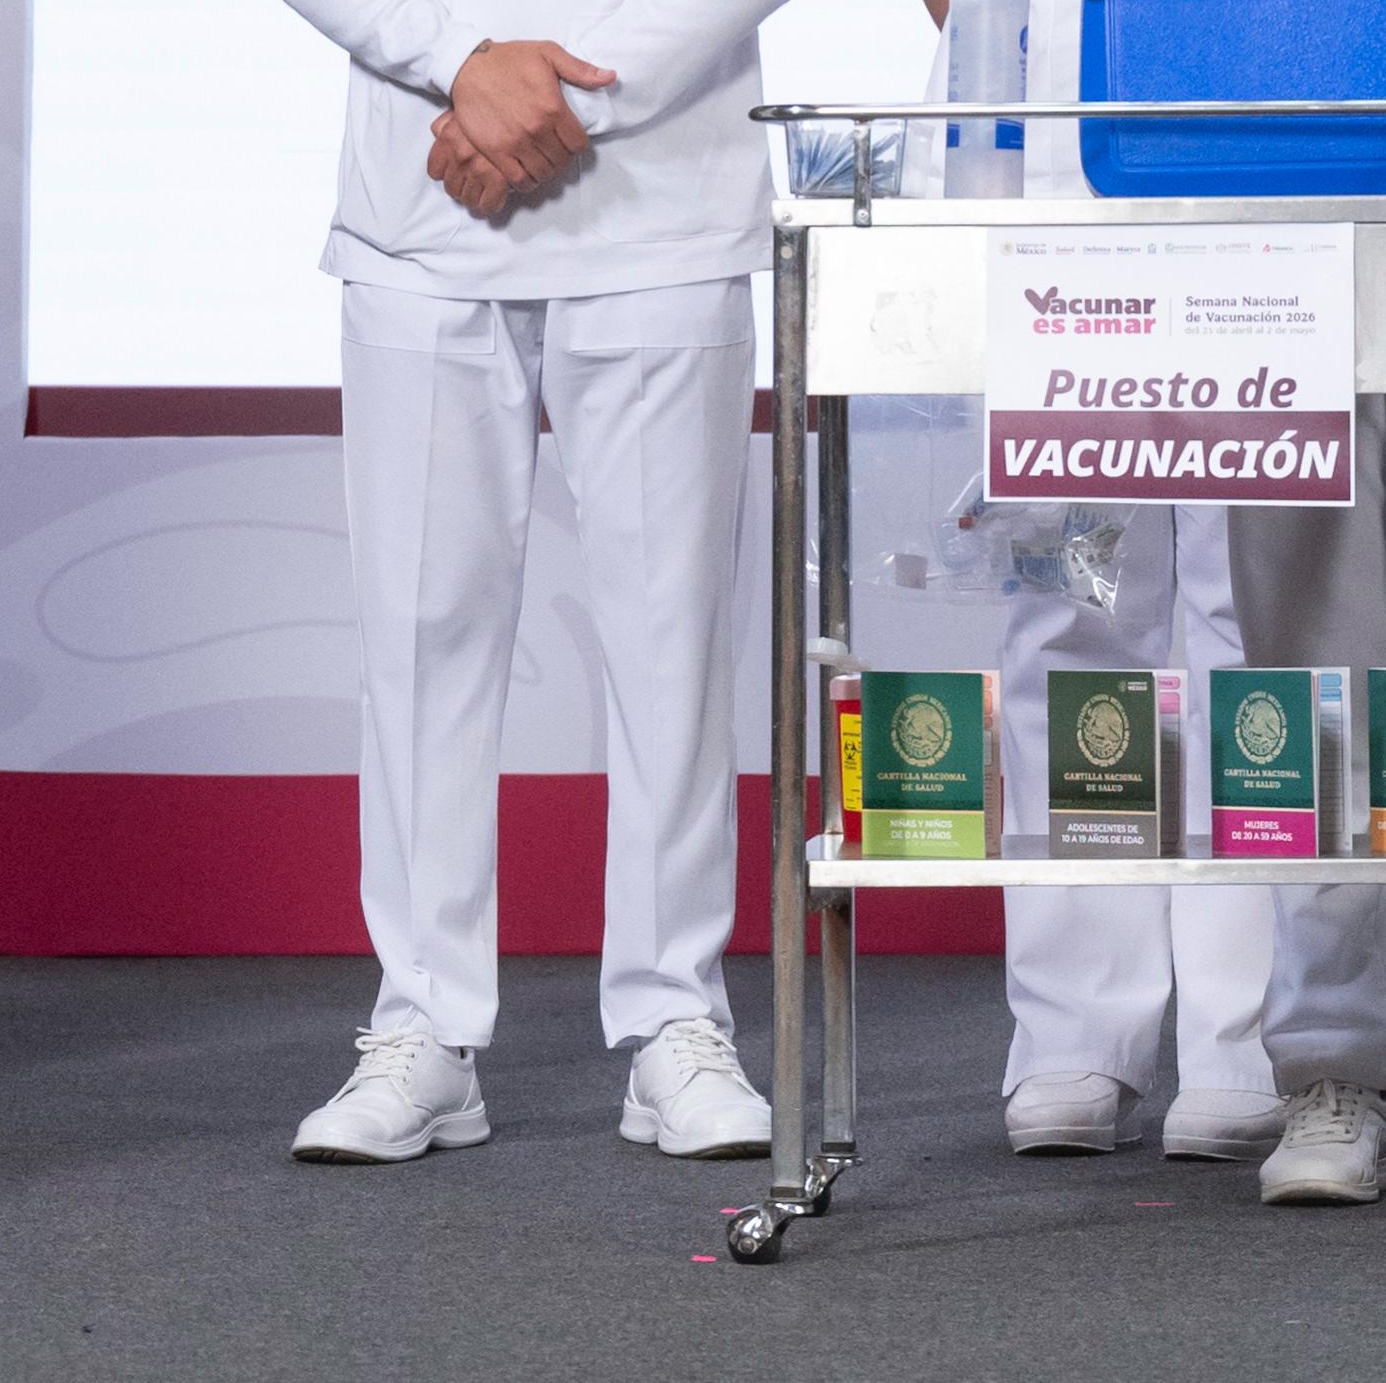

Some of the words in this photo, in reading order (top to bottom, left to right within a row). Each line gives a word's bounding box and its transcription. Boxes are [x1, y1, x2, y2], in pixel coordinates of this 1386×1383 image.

[1024, 286, 1156, 315] Vacunar
[1185, 296, 1237, 307] Semana
[1242, 296, 1299, 307] Nacional
[1185, 312, 1201, 323] de
[1205, 310, 1281, 323] Vacunación
[1286, 312, 1316, 323] 2026
[1033, 317, 1066, 335] es
[1073, 317, 1156, 335] amar
[1043, 369, 1219, 408] Puesto
[1237, 367, 1297, 408] de
[1003, 430, 1340, 479] VACUNACIÓN
[922, 773, 967, 781] NACIONAL
[915, 784, 944, 792] SALUD
[1067, 823, 1126, 833] ADOLESCENTES
[1244, 820, 1279, 830] MUJERES
